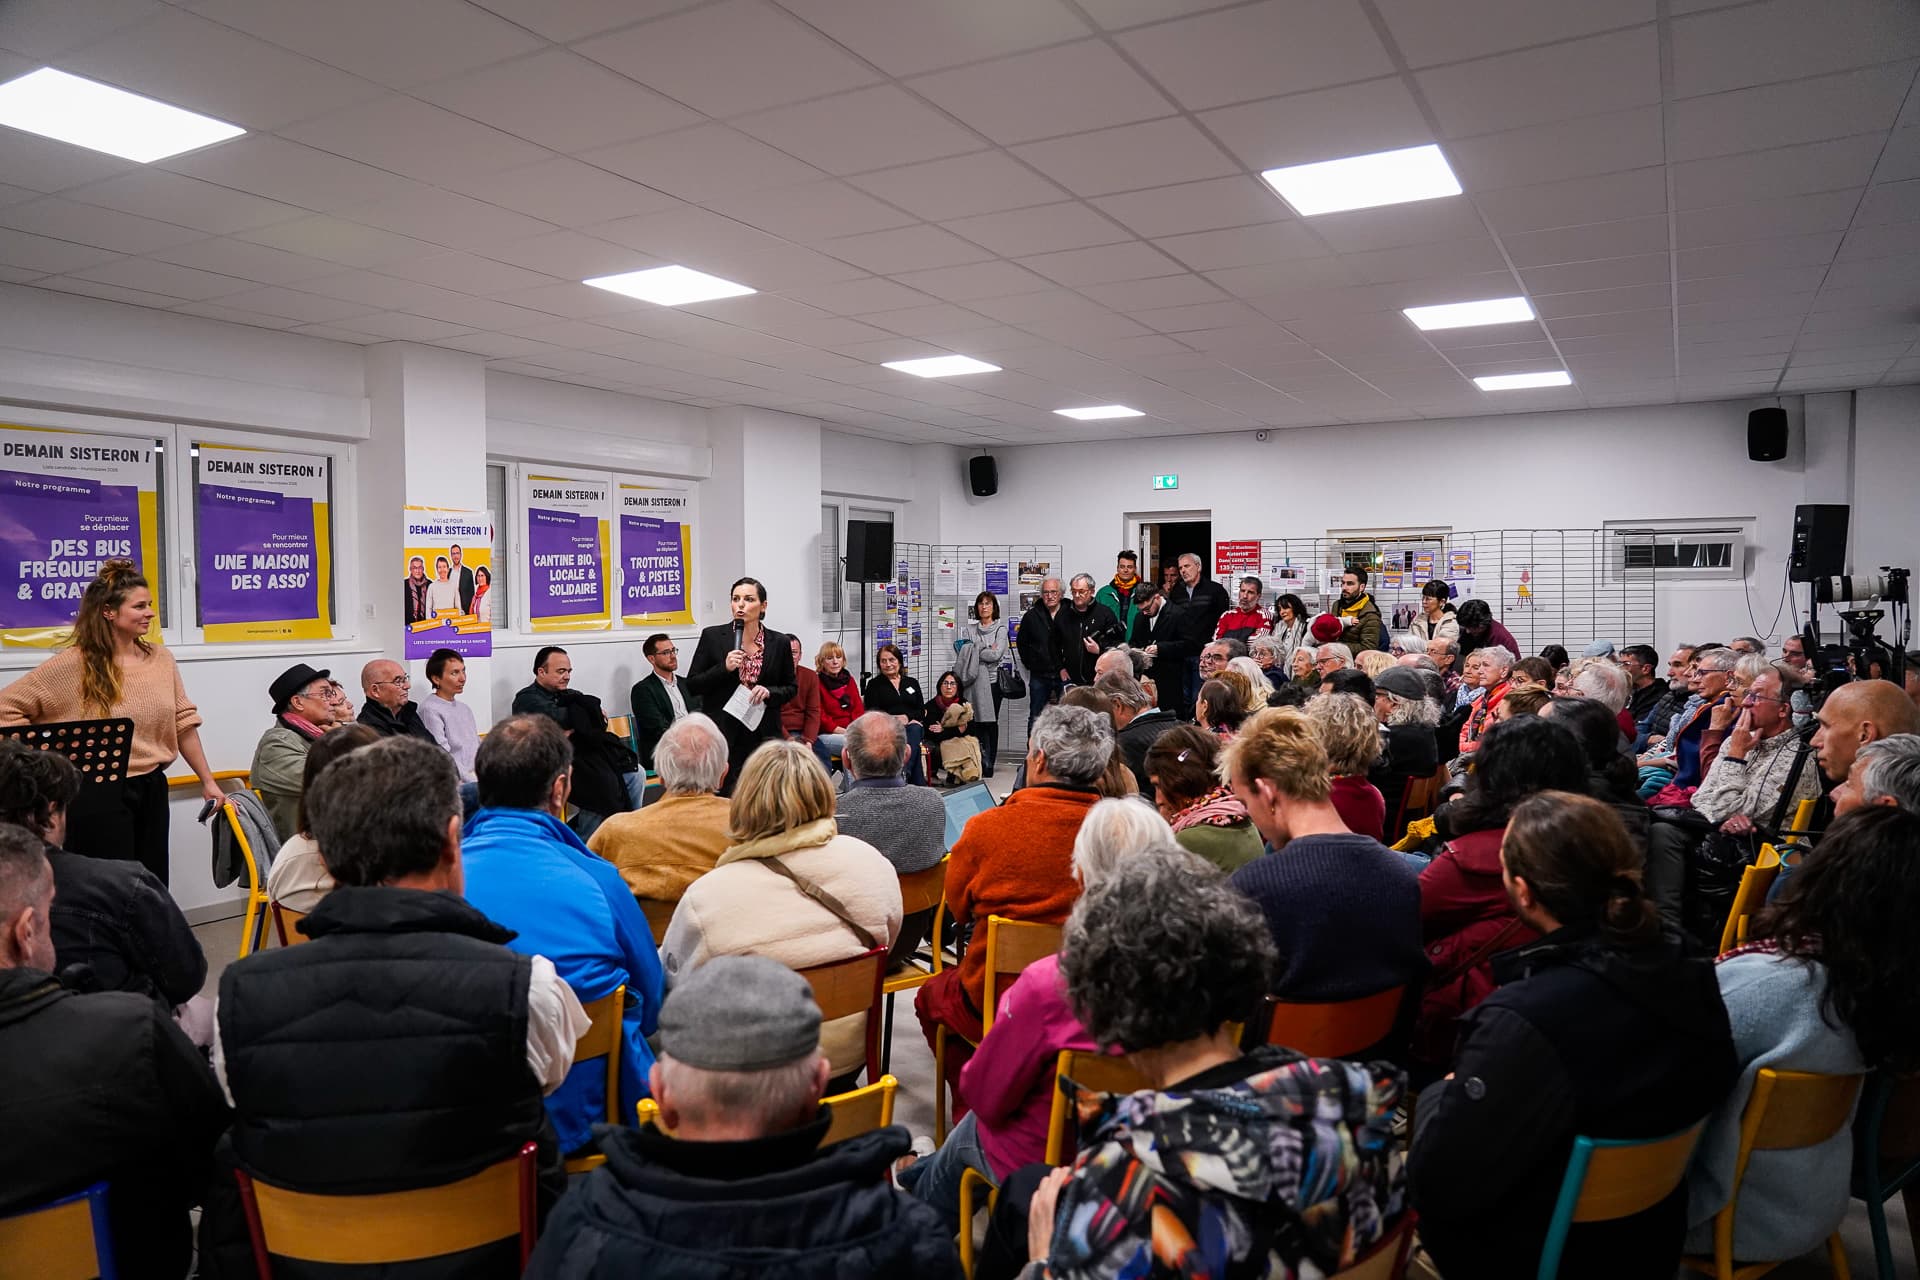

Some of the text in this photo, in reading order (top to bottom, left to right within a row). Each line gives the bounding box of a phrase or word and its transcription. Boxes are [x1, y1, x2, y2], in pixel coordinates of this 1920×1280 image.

[4, 443, 63, 459] DEMAIN
[70, 447, 139, 463] SISTERON
[208, 460, 254, 474] DEMAIN
[259, 463, 314, 477] SISTERON
[15, 480, 91, 494] Notre programme
[237, 496, 275, 505] programme
[533, 489, 563, 499] DEMAIN
[565, 490, 599, 500] SISTERON
[624, 497, 649, 506] DEMAIN
[651, 498, 681, 507] SISTERON
[84, 514, 129, 522] Pour mieux
[92, 523, 130, 533] déplacer
[409, 525, 442, 535] DEMAIN
[445, 526, 482, 535] SISTERON
[51, 539, 131, 557] DES BUS
[214, 554, 310, 570] UNE MAISON
[533, 553, 596, 567] CANTINE BIO,
[630, 556, 679, 569] TROTTOIRS
[231, 574, 262, 590] DES
[549, 568, 596, 582] LOCALE &
[639, 569, 680, 583] & PISTES
[17, 583, 33, 600] &
[549, 582, 597, 596] SOLIDAIRE
[628, 583, 681, 598] CYCLABLES
